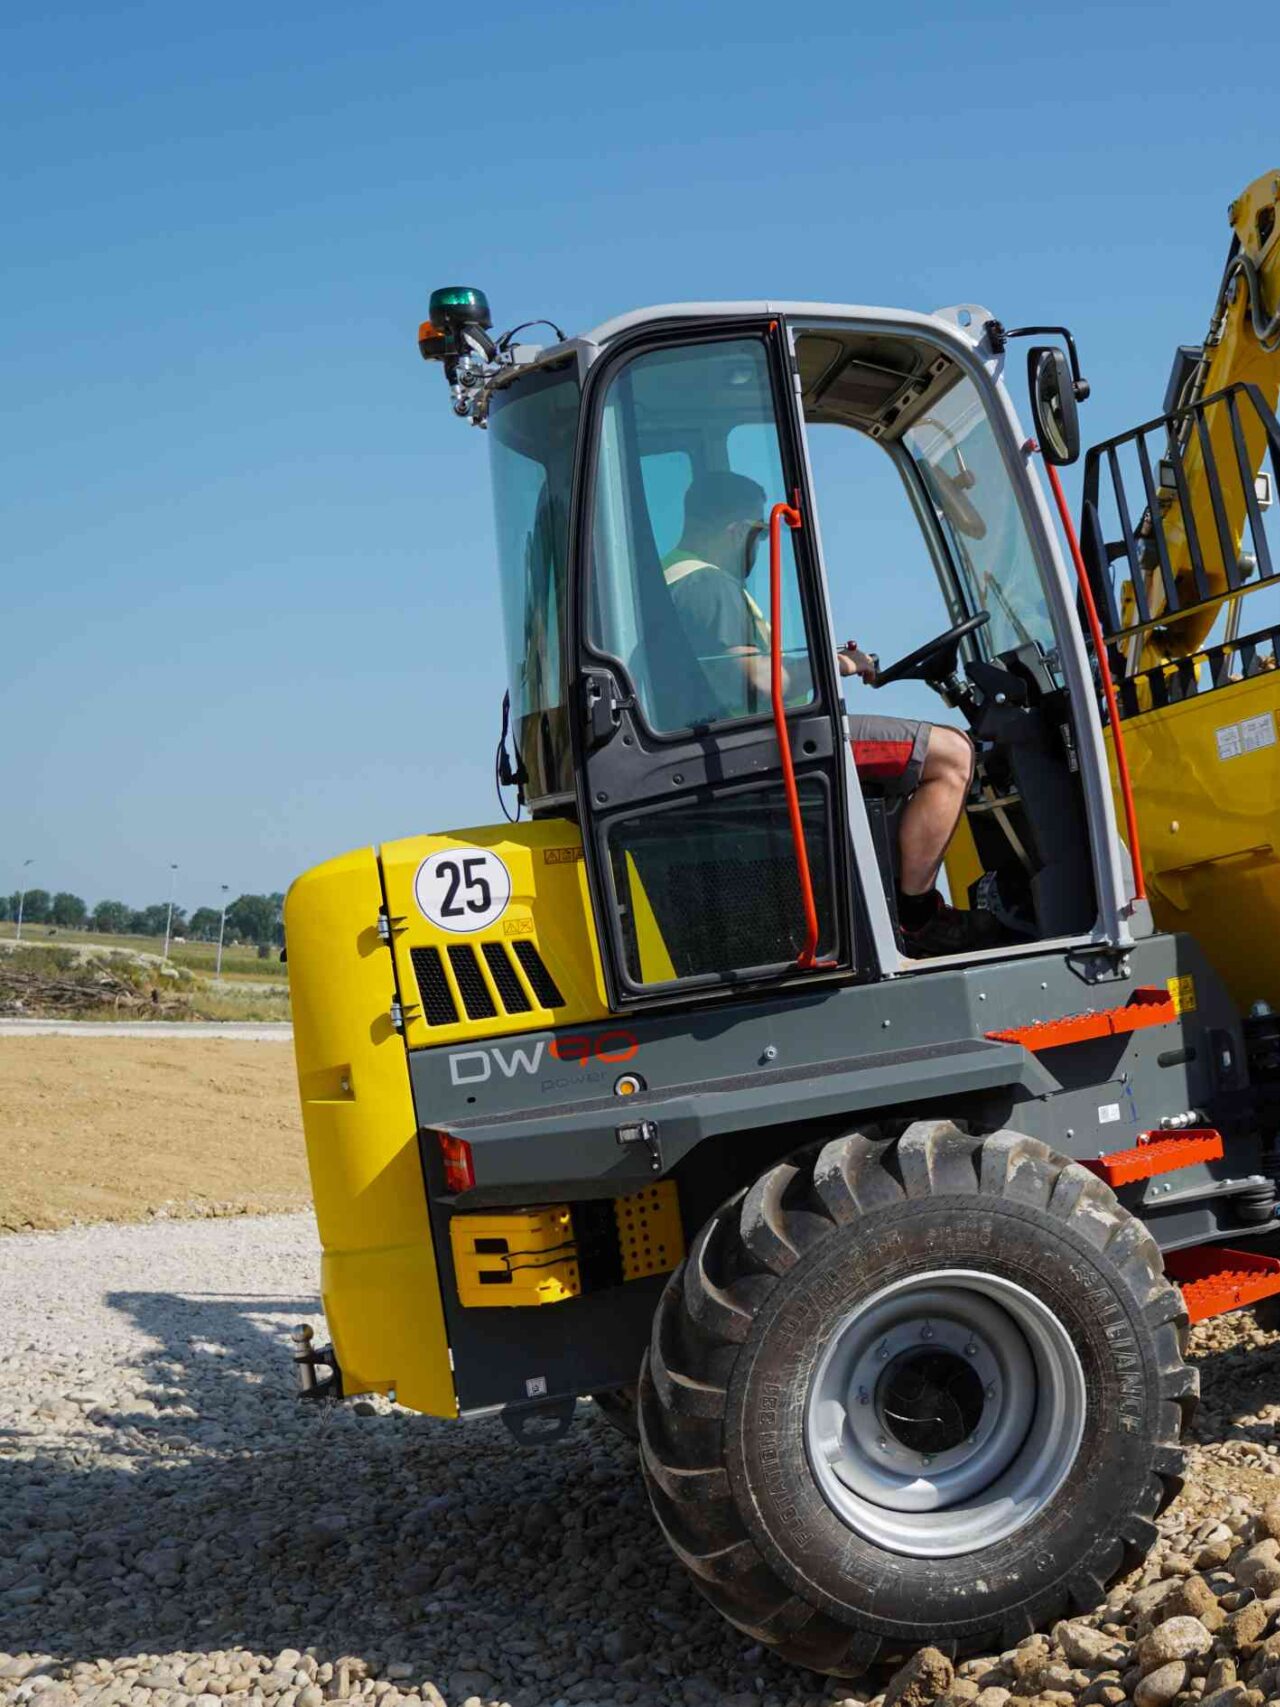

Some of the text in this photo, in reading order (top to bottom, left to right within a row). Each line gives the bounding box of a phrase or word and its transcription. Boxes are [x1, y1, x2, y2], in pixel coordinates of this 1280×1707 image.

[435, 857, 491, 918] 25
[1082, 1285, 1146, 1435] ALLIANCE
[759, 1431, 815, 1547] FLOTATION
